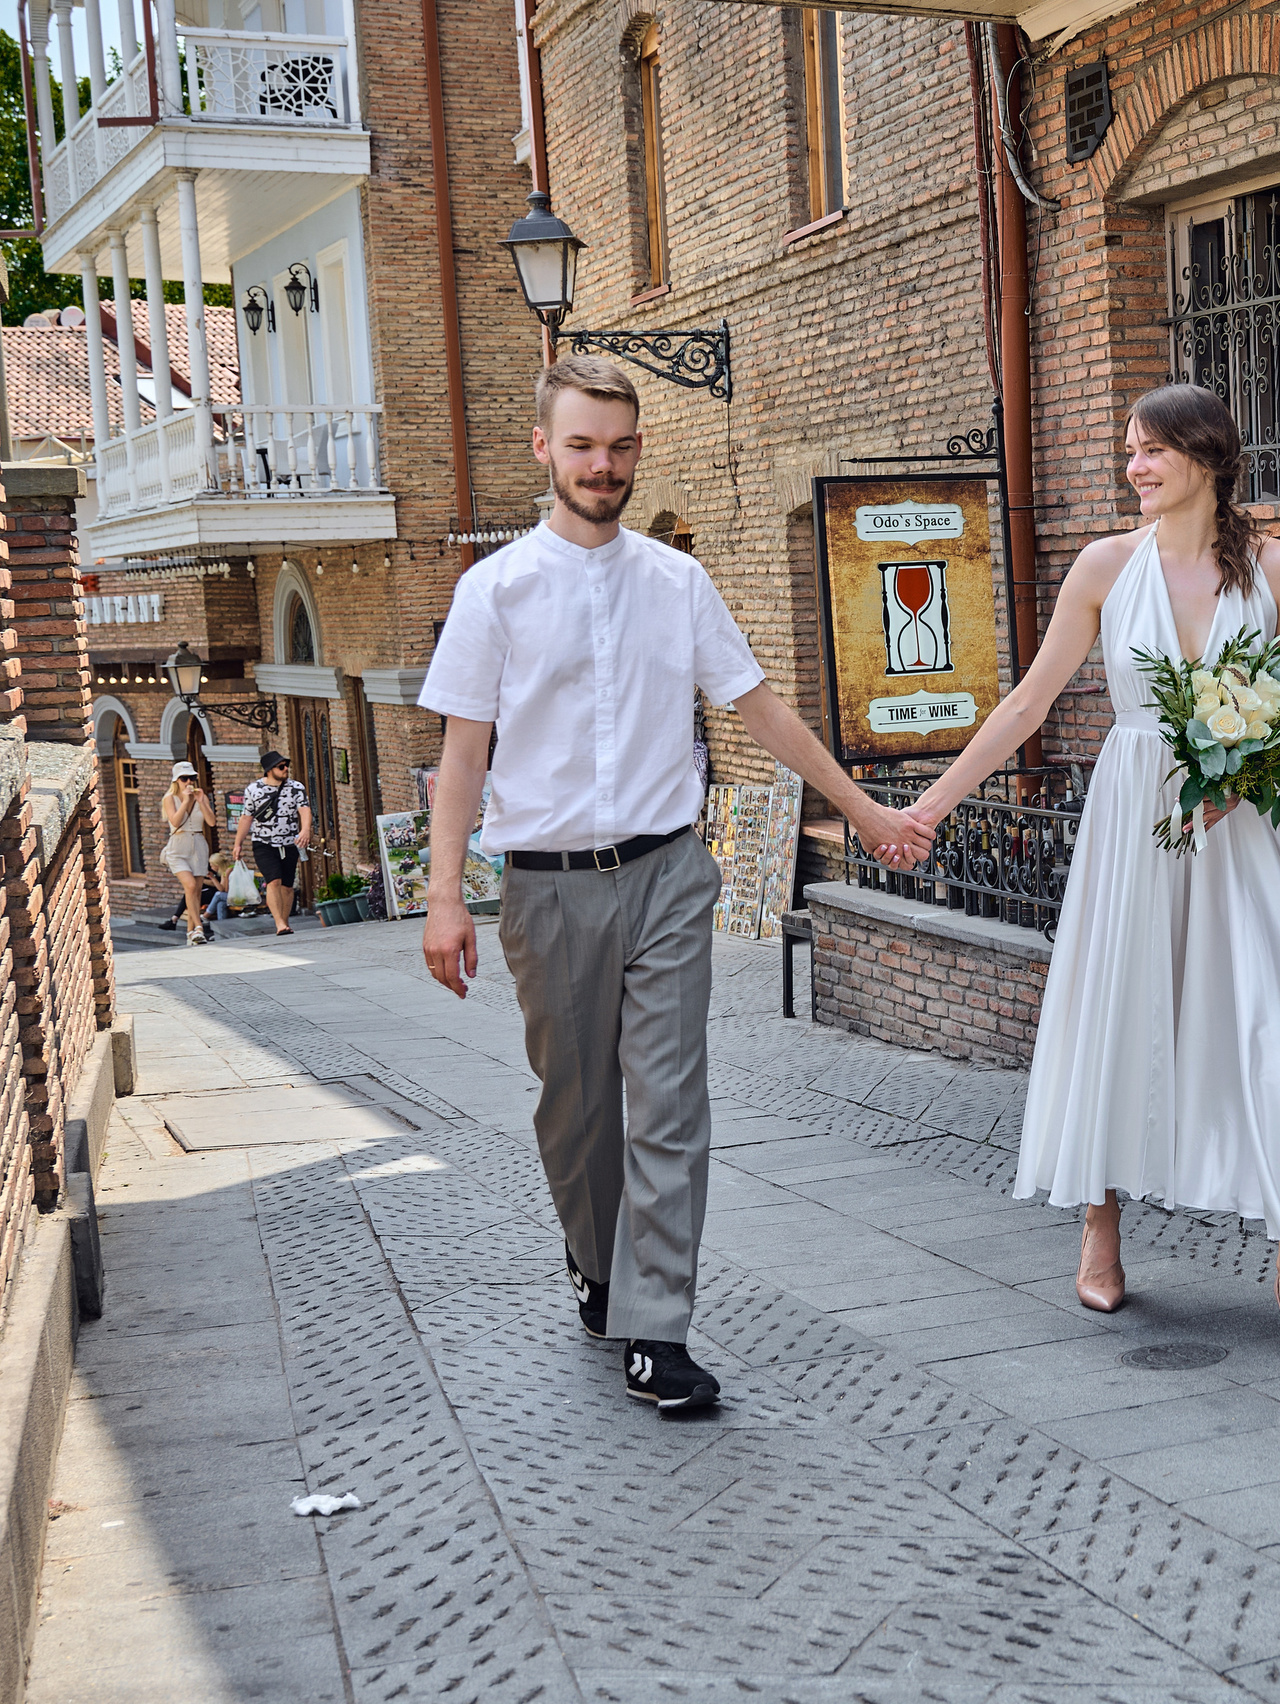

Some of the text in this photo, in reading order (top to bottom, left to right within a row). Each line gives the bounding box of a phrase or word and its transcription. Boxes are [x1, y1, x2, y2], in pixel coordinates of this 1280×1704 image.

[915, 515, 950, 529] Space
[888, 707, 917, 720] TIME
[928, 704, 958, 717] WINE
